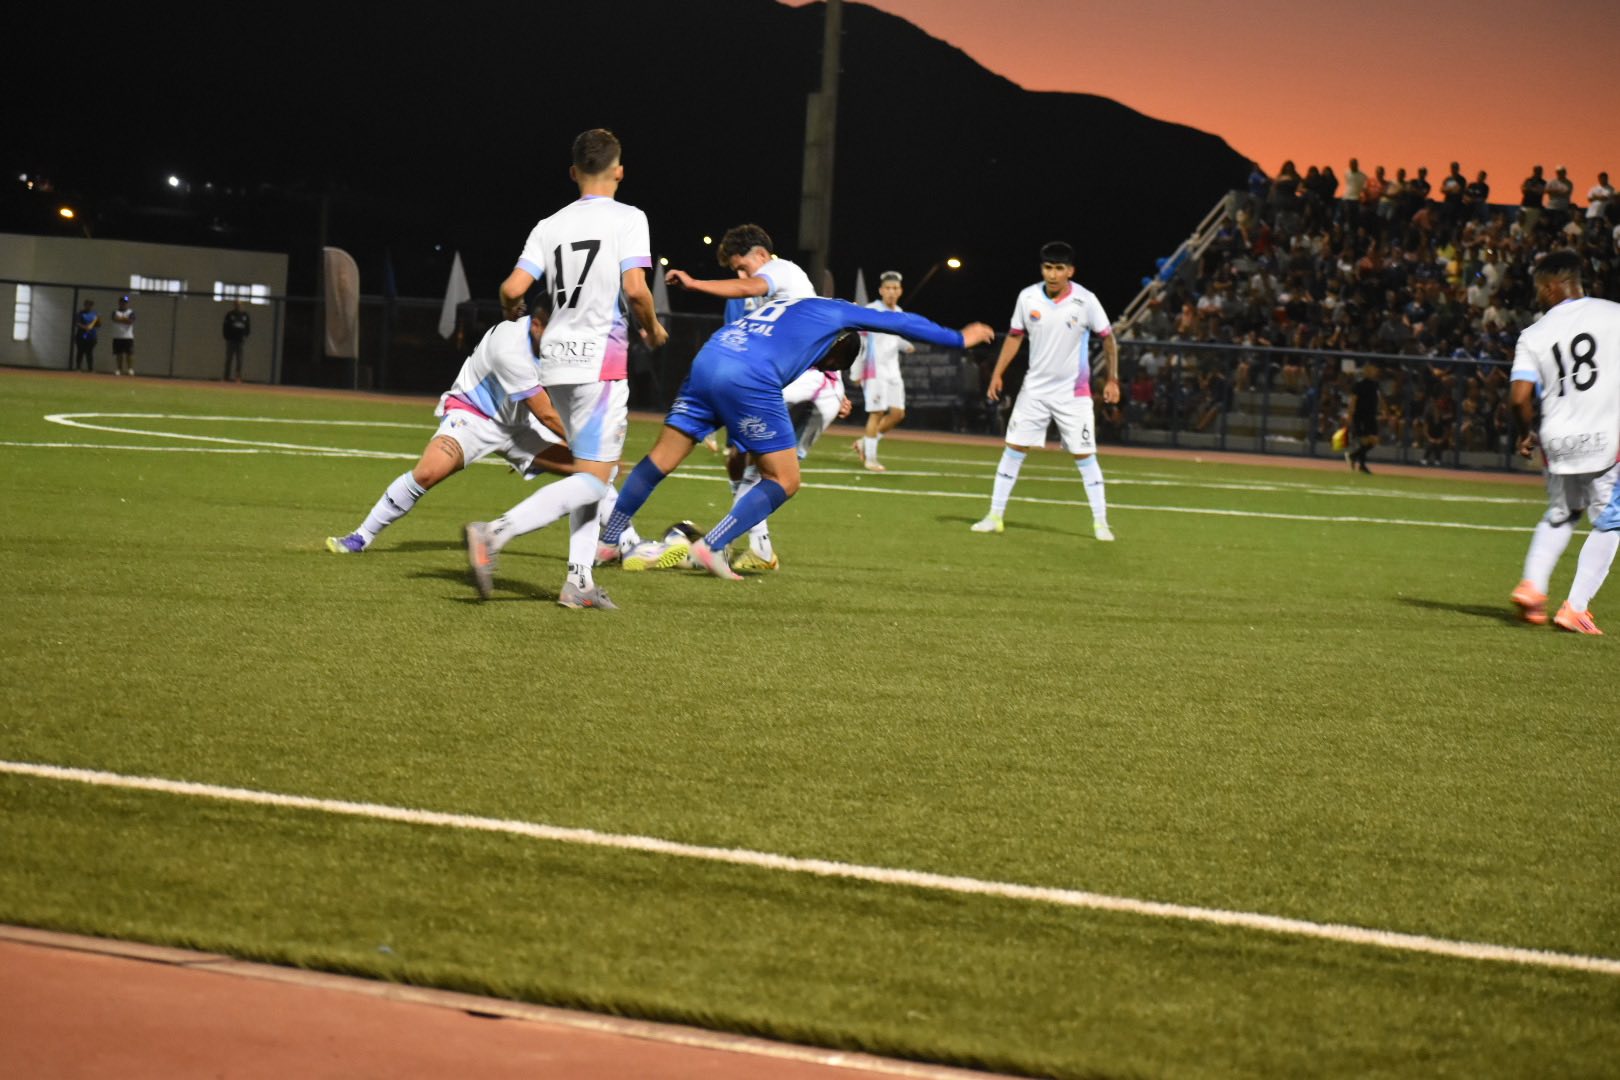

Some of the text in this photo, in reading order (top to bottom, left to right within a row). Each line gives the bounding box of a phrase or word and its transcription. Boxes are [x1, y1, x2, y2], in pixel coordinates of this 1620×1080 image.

[554, 239, 602, 309] 17
[541, 341, 597, 360] CORE
[1552, 332, 1598, 397] 18
[1082, 424, 1090, 441] 6
